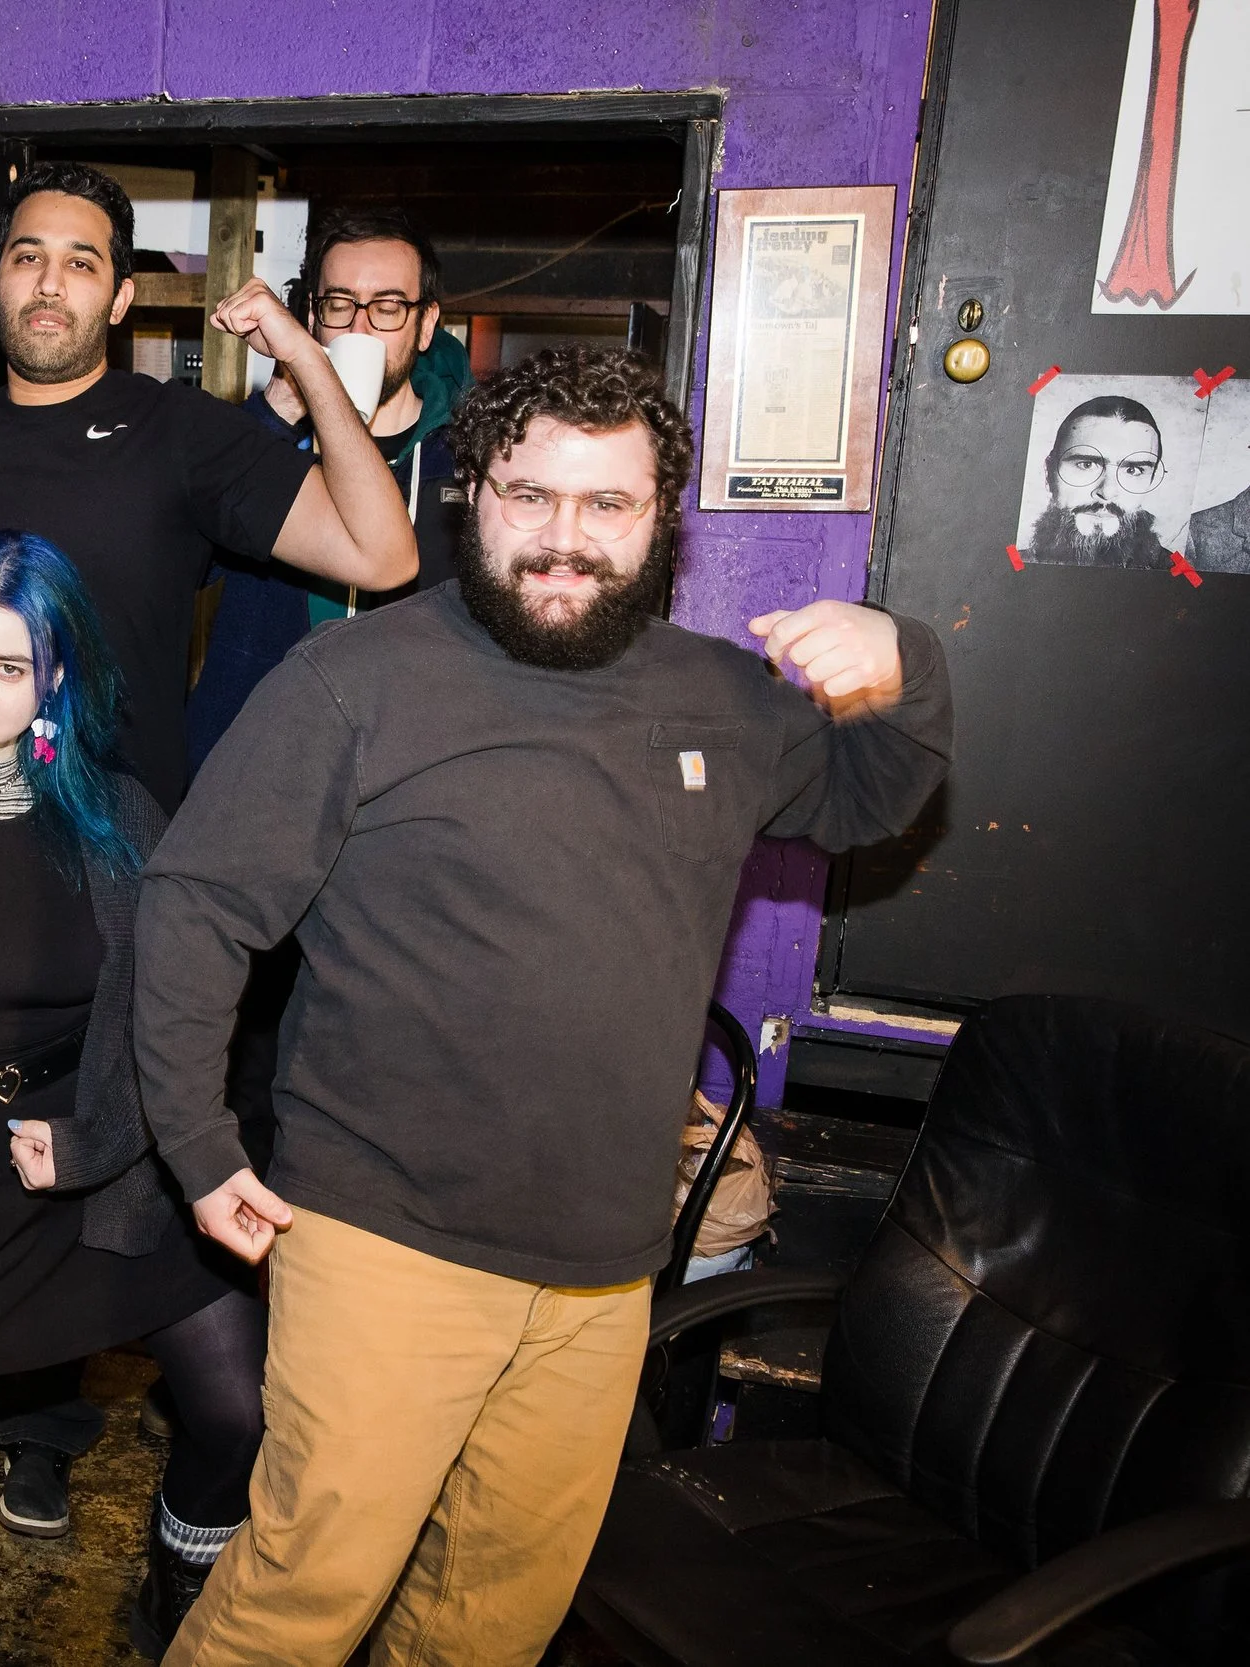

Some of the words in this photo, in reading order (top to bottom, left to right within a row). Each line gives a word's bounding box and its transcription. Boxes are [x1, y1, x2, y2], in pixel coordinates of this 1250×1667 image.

[752, 478, 775, 486] TAJ
[776, 478, 824, 487] MAHAL
[773, 486, 788, 494] The
[790, 486, 812, 494] Metro
